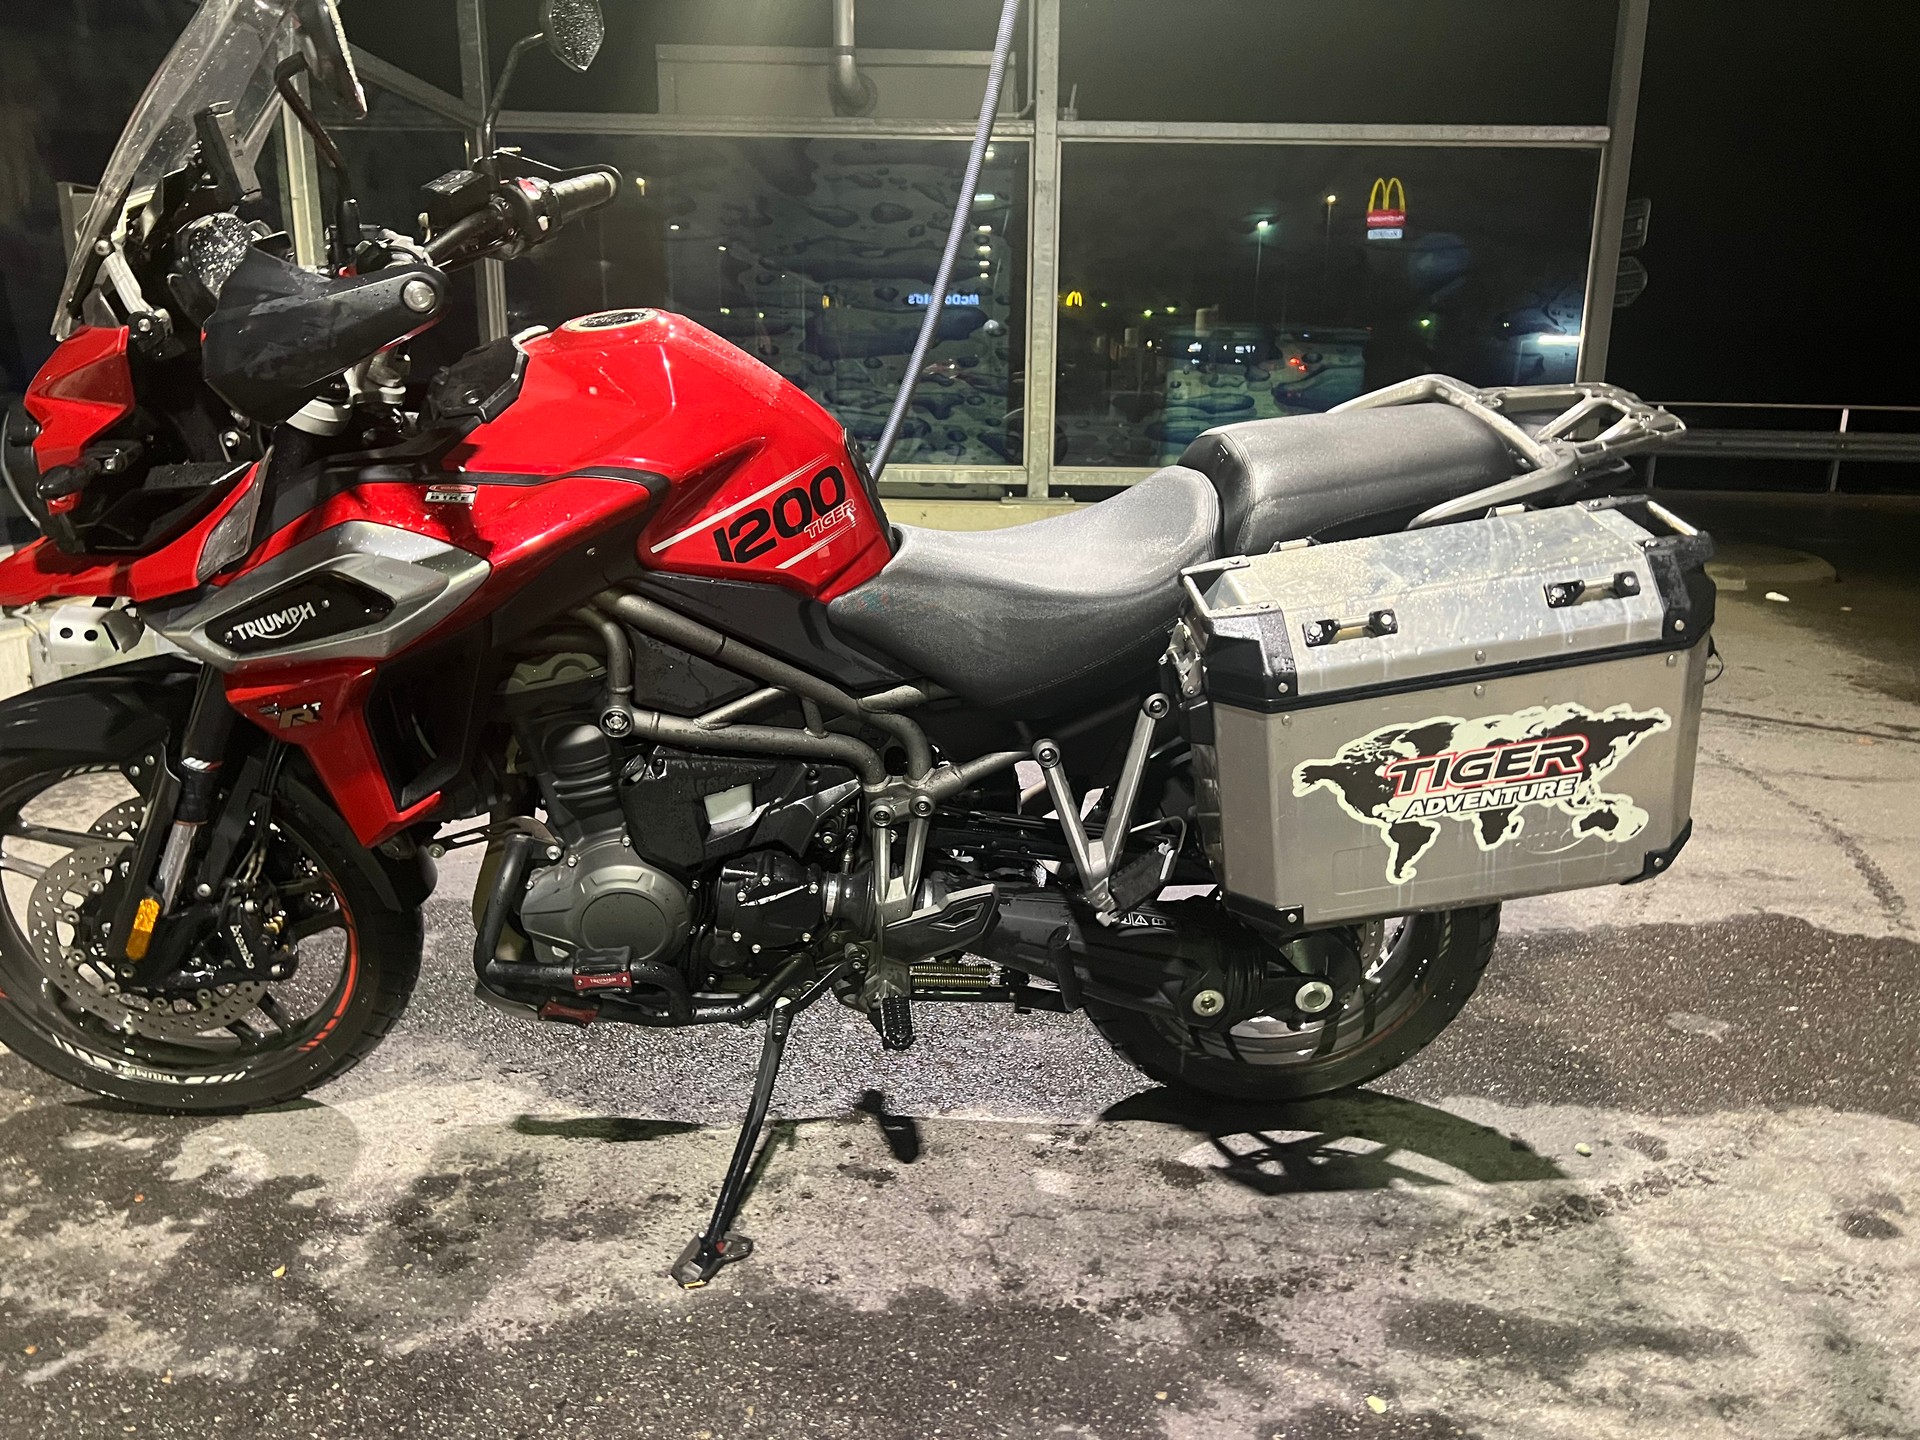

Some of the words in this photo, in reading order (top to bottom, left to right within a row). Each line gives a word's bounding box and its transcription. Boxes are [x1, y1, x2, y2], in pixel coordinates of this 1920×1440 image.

[712, 465, 846, 564] 1200
[803, 498, 857, 539] TIGER
[232, 601, 317, 640] TRIUMPH
[1386, 736, 1588, 796] TIGER
[1399, 776, 1580, 821] ADVENTURE
[229, 924, 255, 969] brembo
